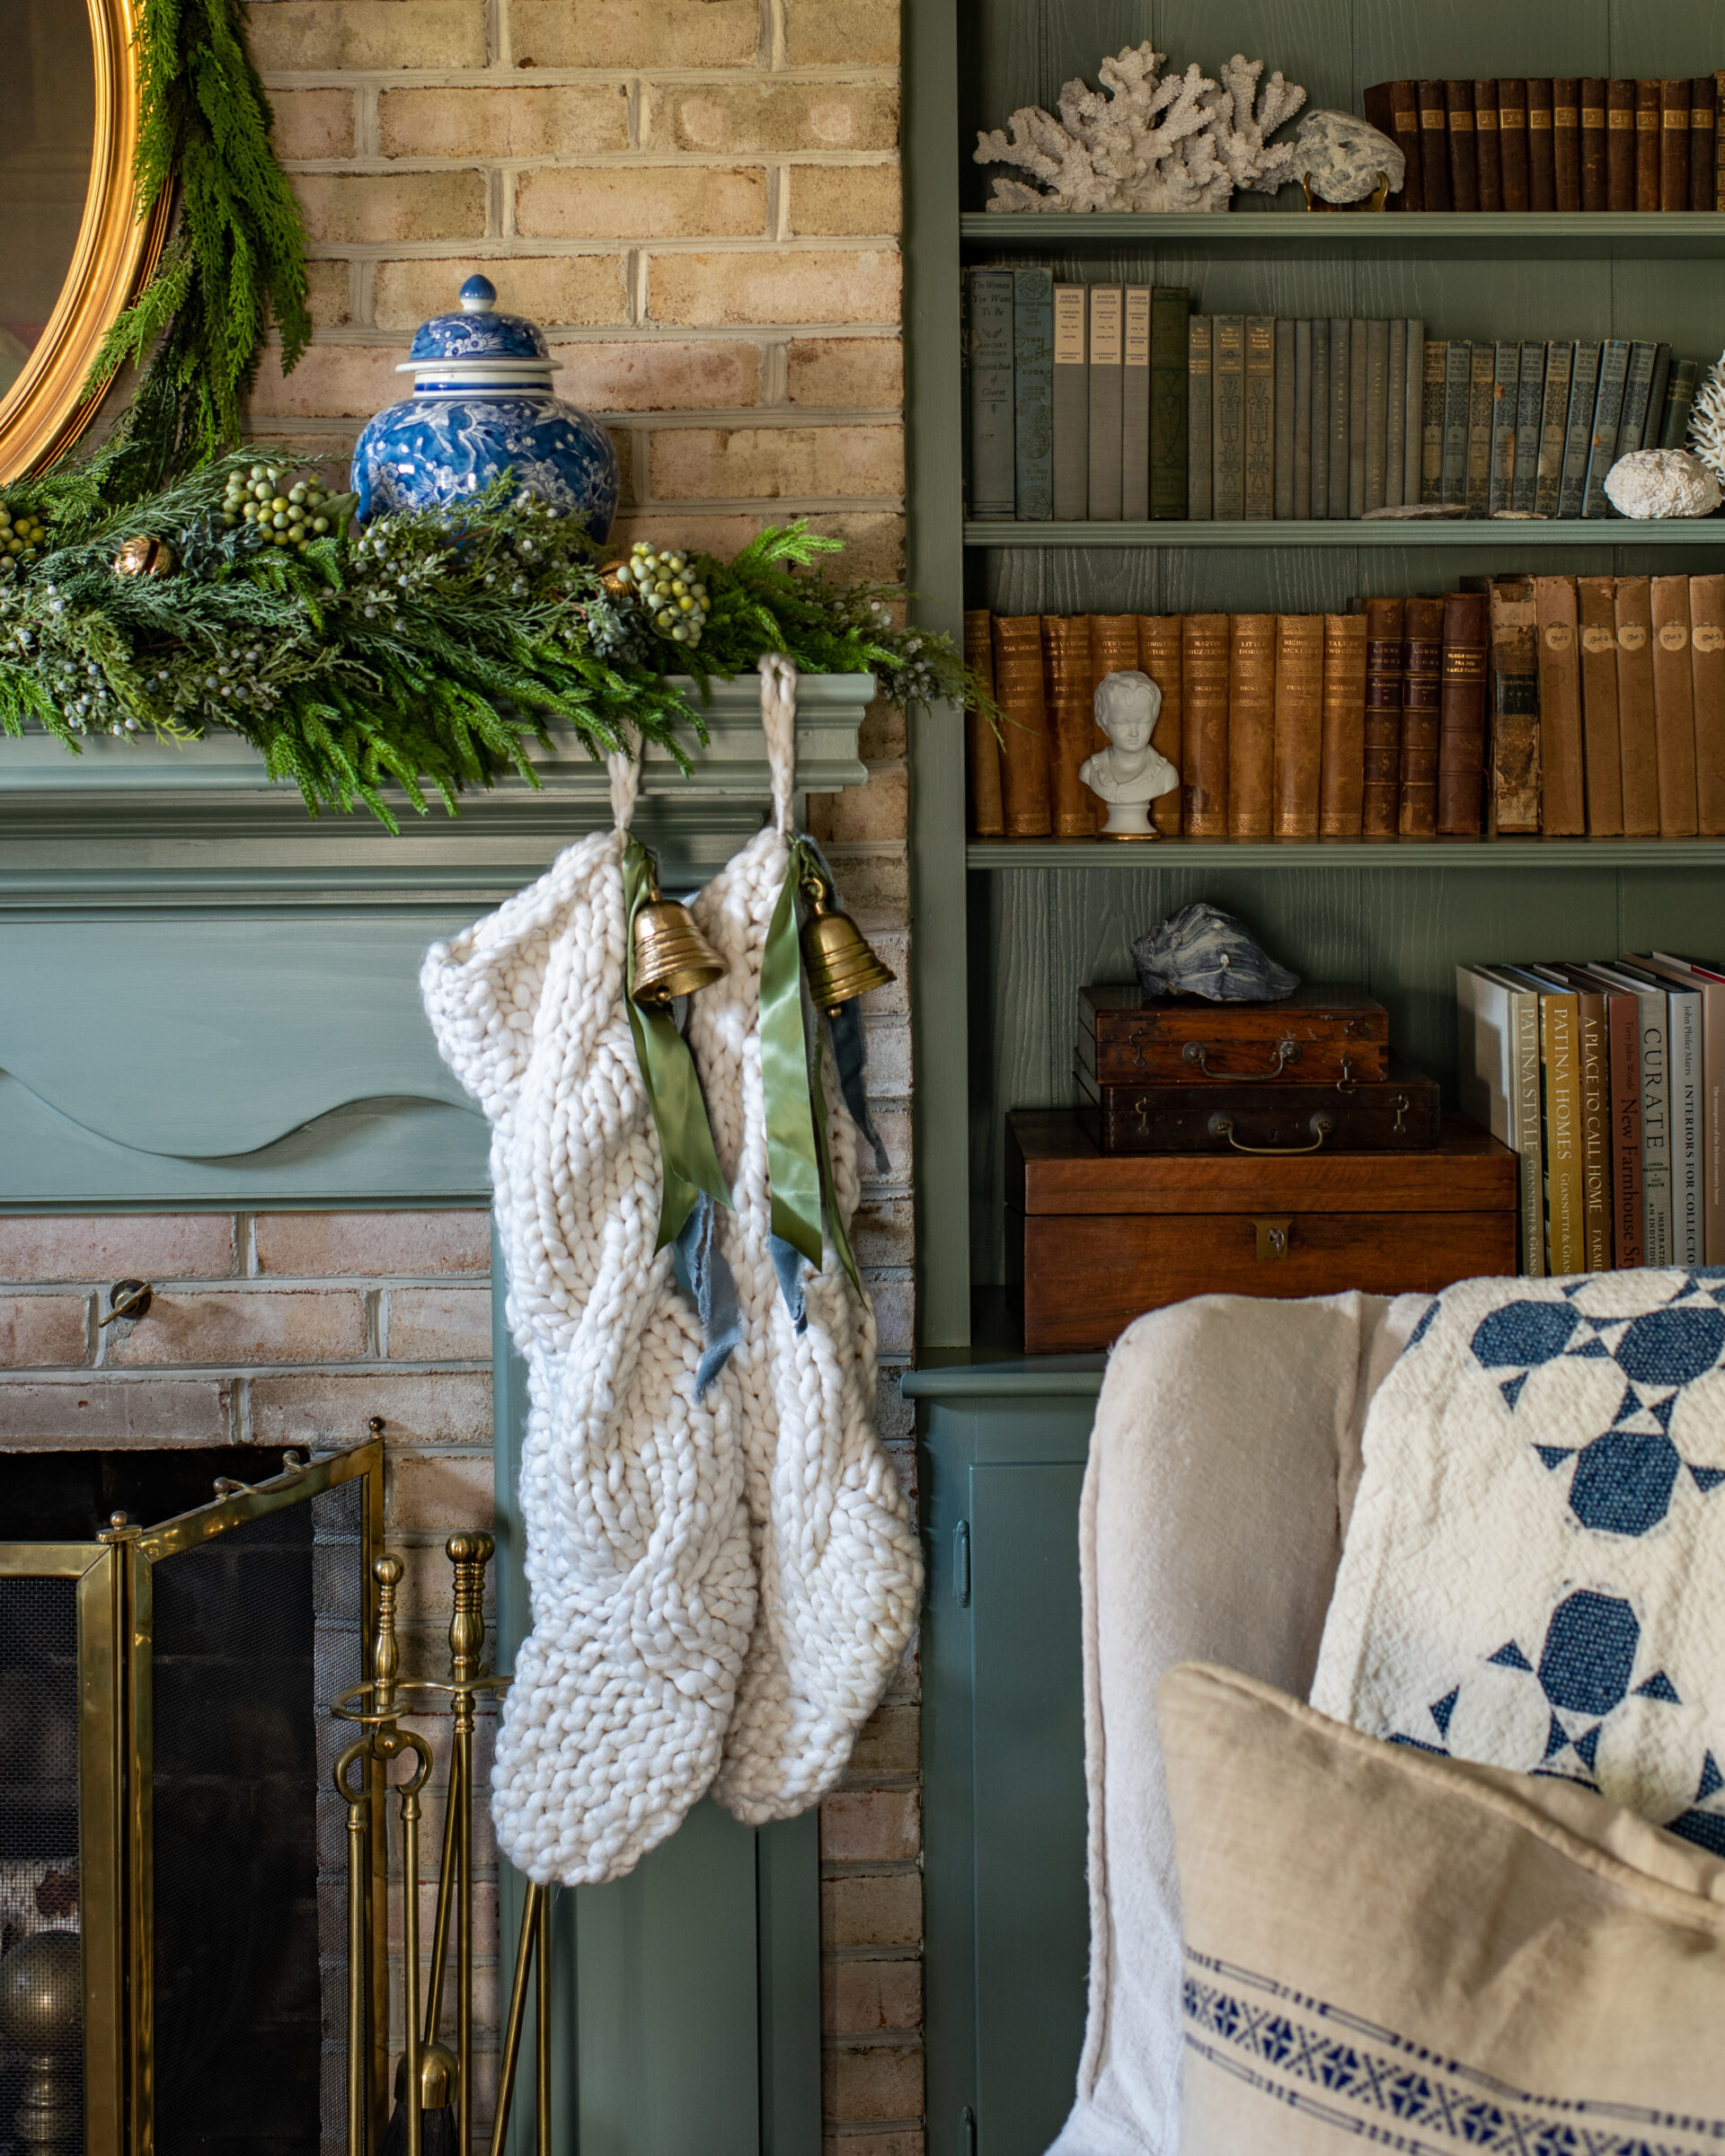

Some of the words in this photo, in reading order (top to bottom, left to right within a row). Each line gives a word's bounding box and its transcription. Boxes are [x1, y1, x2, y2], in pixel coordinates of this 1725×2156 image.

[1429, 114, 1441, 124] 21
[1482, 114, 1495, 125] 23
[1507, 113, 1523, 123] 24
[1535, 115, 1548, 124] 25
[1588, 113, 1603, 123] 27
[1617, 114, 1629, 124] 28
[1642, 114, 1656, 124] 29
[1667, 115, 1683, 124] 30
[1693, 113, 1707, 123] 31
[986, 281, 1010, 289] Woman
[973, 295, 987, 303] You
[991, 295, 1013, 303] Want
[995, 307, 1004, 315] Be
[1337, 342, 1345, 374] HENRY
[982, 388, 1006, 396] Charm
[1337, 382, 1345, 401] THE
[1337, 409, 1345, 439] FIFTH
[1585, 1016, 1597, 1028] A
[1683, 1005, 1692, 1024] John
[1624, 1021, 1633, 1041] Terry
[1521, 1008, 1536, 1082] PATINA
[1554, 1008, 1569, 1081] PATINA
[1624, 1042, 1634, 1061] John
[1586, 1034, 1599, 1085] PLACE
[1684, 1053, 1693, 1076] Marrs
[1643, 1028, 1664, 1149] CURATE
[1587, 1090, 1600, 1112] TO
[1523, 1088, 1538, 1151] STYLE
[1556, 1088, 1571, 1159] HOMES
[1621, 1098, 1637, 1139] New
[1685, 1084, 1694, 1159] INTERIORS
[1587, 1117, 1601, 1160] CALL
[1685, 1162, 1695, 1188] FOR
[1526, 1159, 1537, 1223] GIANNETTI
[1588, 1165, 1603, 1214] HOME
[1622, 1144, 1640, 1241] Farmhouse
[1560, 1172, 1570, 1231] GIANNETTI
[1649, 1202, 1656, 1215] AN
[1527, 1225, 1537, 1234] &
[1561, 1233, 1570, 1243] &
[1685, 1192, 1696, 1268] COLLECTO
[1561, 1244, 1571, 1276] GIAN
